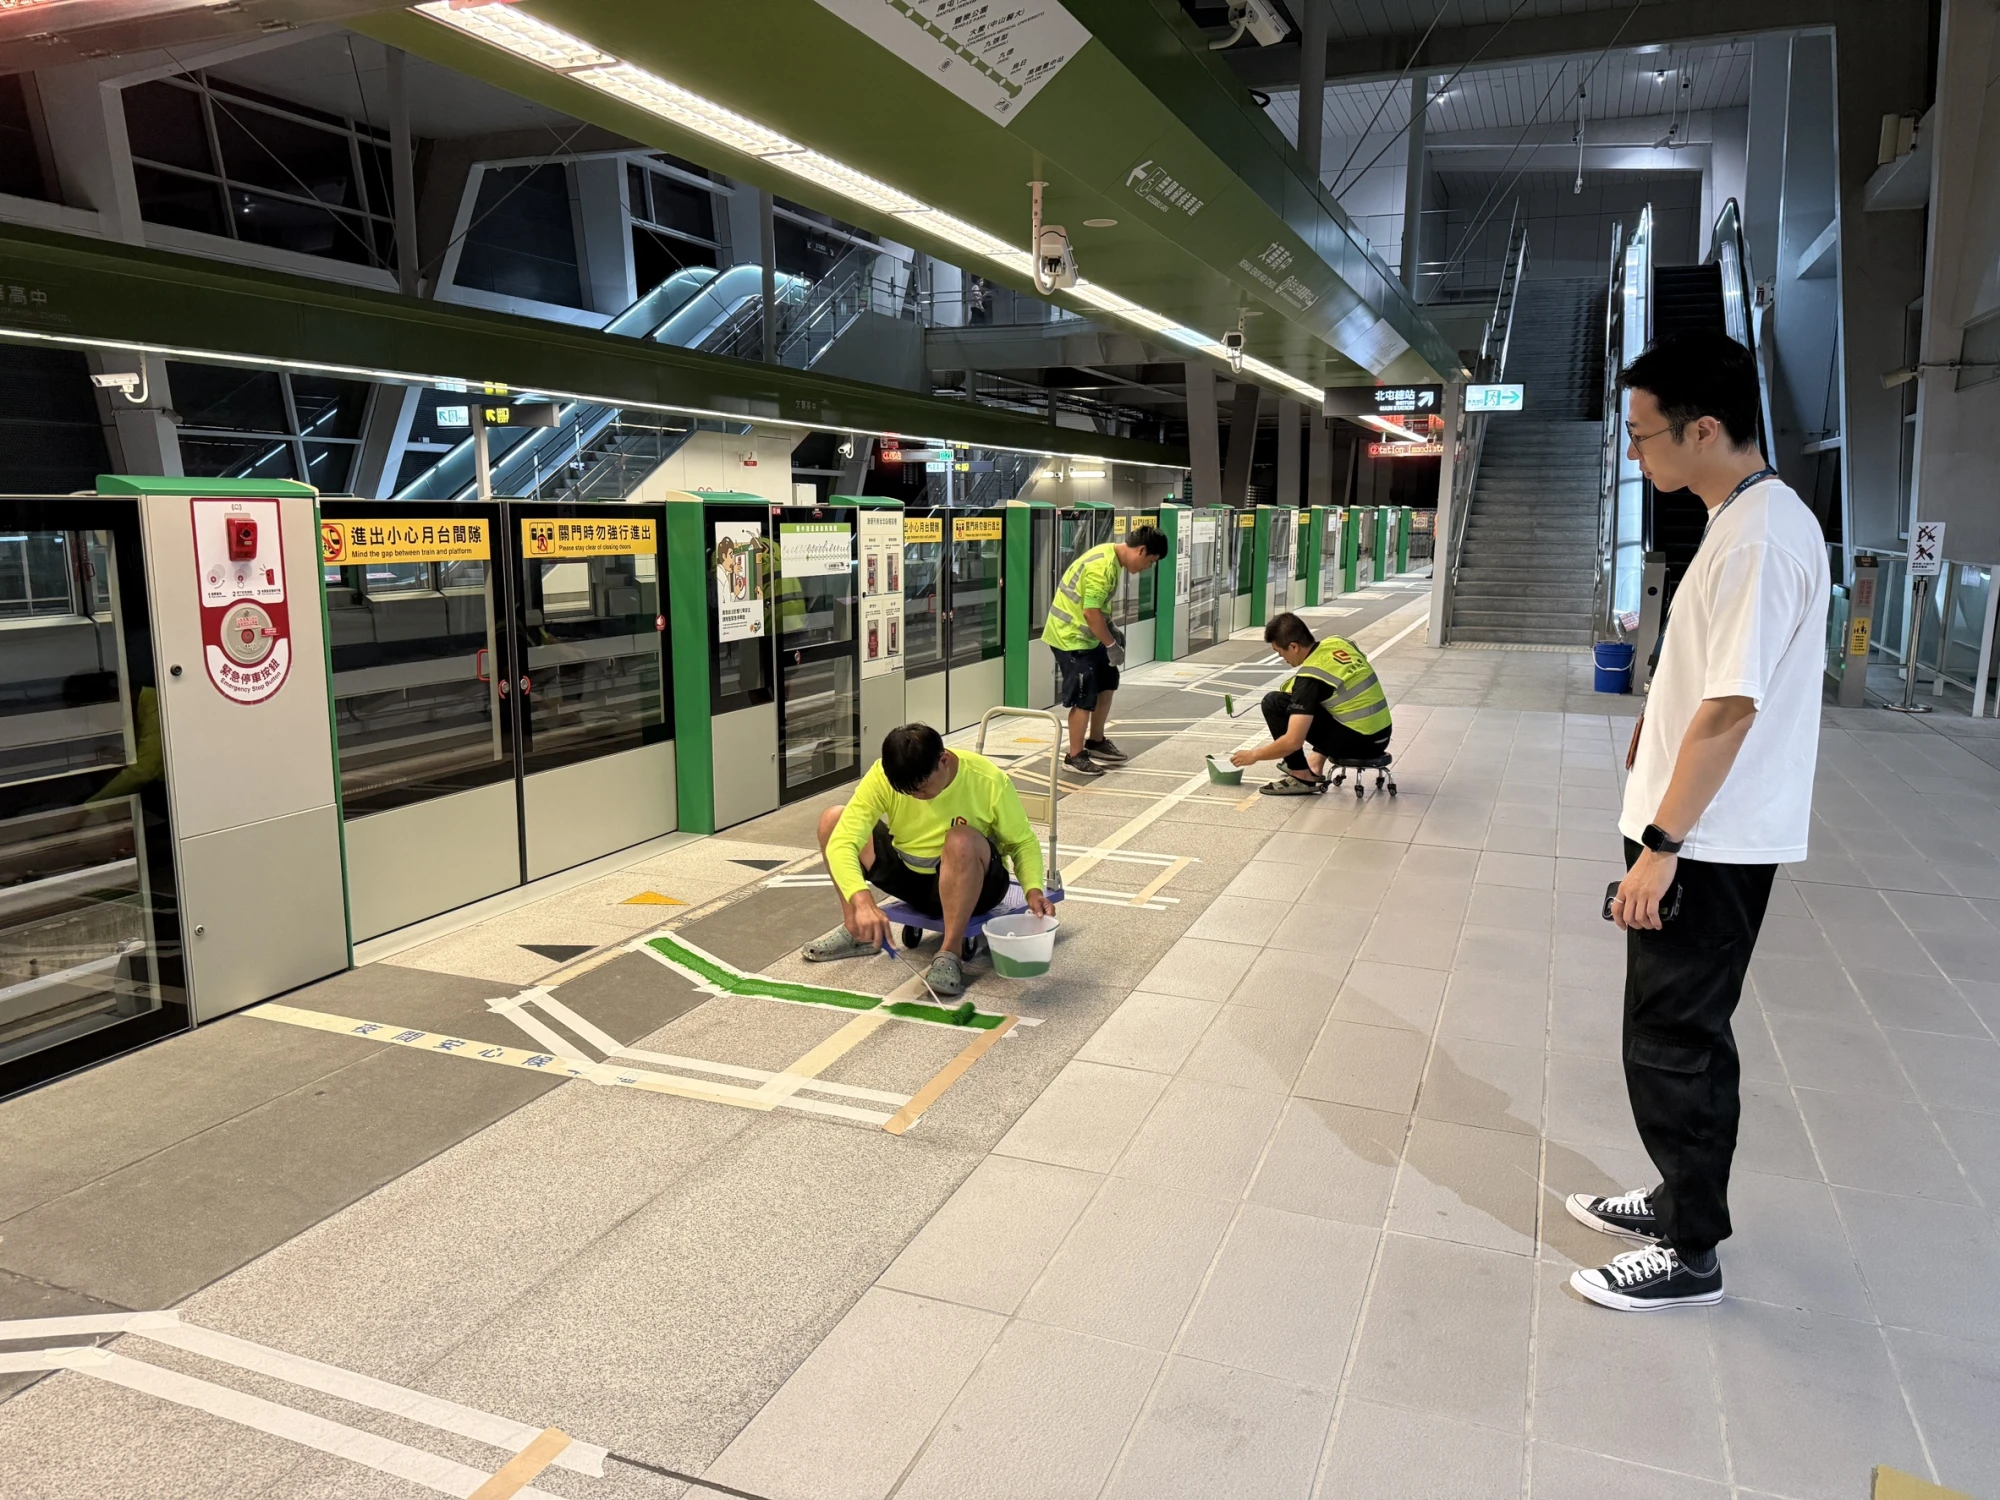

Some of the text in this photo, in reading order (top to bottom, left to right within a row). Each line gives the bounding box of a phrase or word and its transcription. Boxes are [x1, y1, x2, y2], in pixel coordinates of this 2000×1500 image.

[1375, 389, 1416, 401] 北屯總站
[1740, 473, 1761, 488] TMRT
[351, 525, 482, 546] 進出小心月台間隙
[558, 524, 651, 541] 關門時勿強行進出
[449, 548, 472, 556] platform
[219, 658, 280, 686] 緊急停車按鈕
[220, 671, 282, 693] Emergency Stop Button
